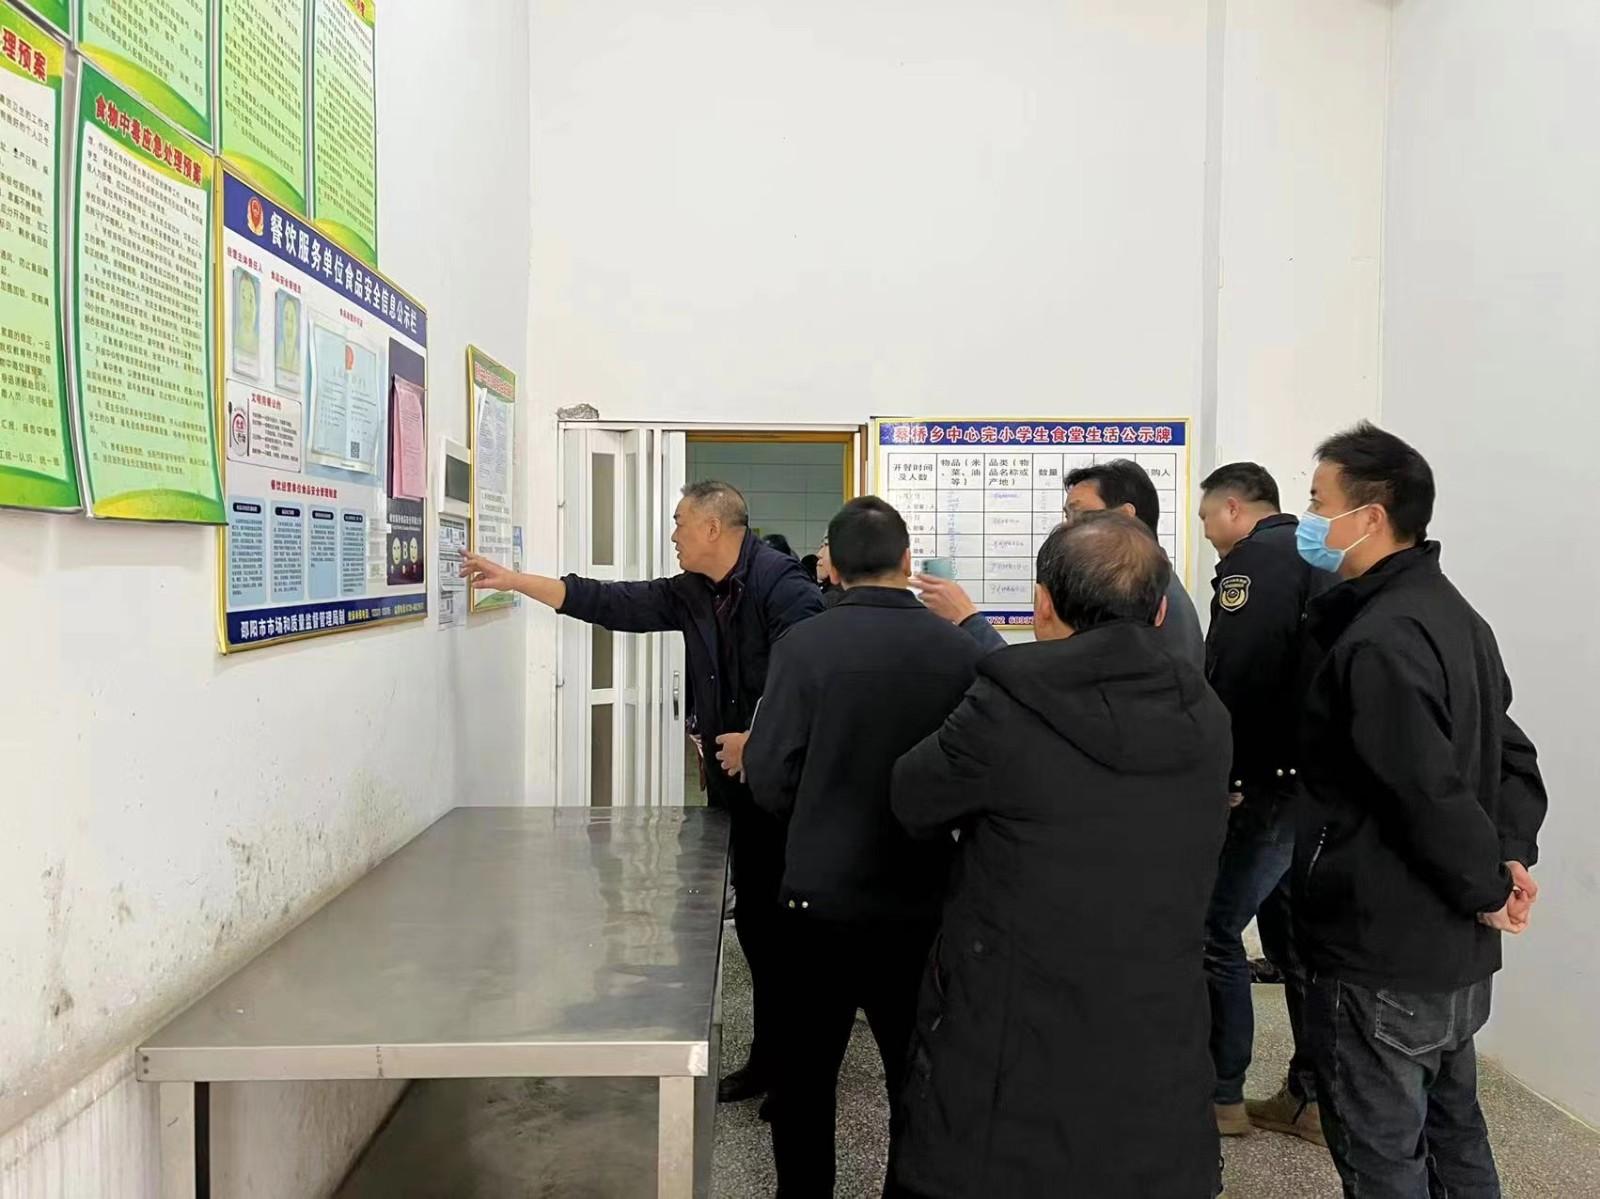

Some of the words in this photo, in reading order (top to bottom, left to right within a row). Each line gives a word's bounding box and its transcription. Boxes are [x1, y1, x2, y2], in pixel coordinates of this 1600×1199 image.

[1, 27, 47, 82] 理预案
[95, 93, 202, 187] 食物中毒应急处理预案
[270, 211, 418, 334] 餐饮服务单位食品安全信息公示栏
[893, 425, 1173, 443] 蔡桥乡中心完小学生食堂生活公示牌
[1038, 468, 1058, 476] 数量
[240, 608, 346, 640] 邵阳市市场和质量监督管理局制
